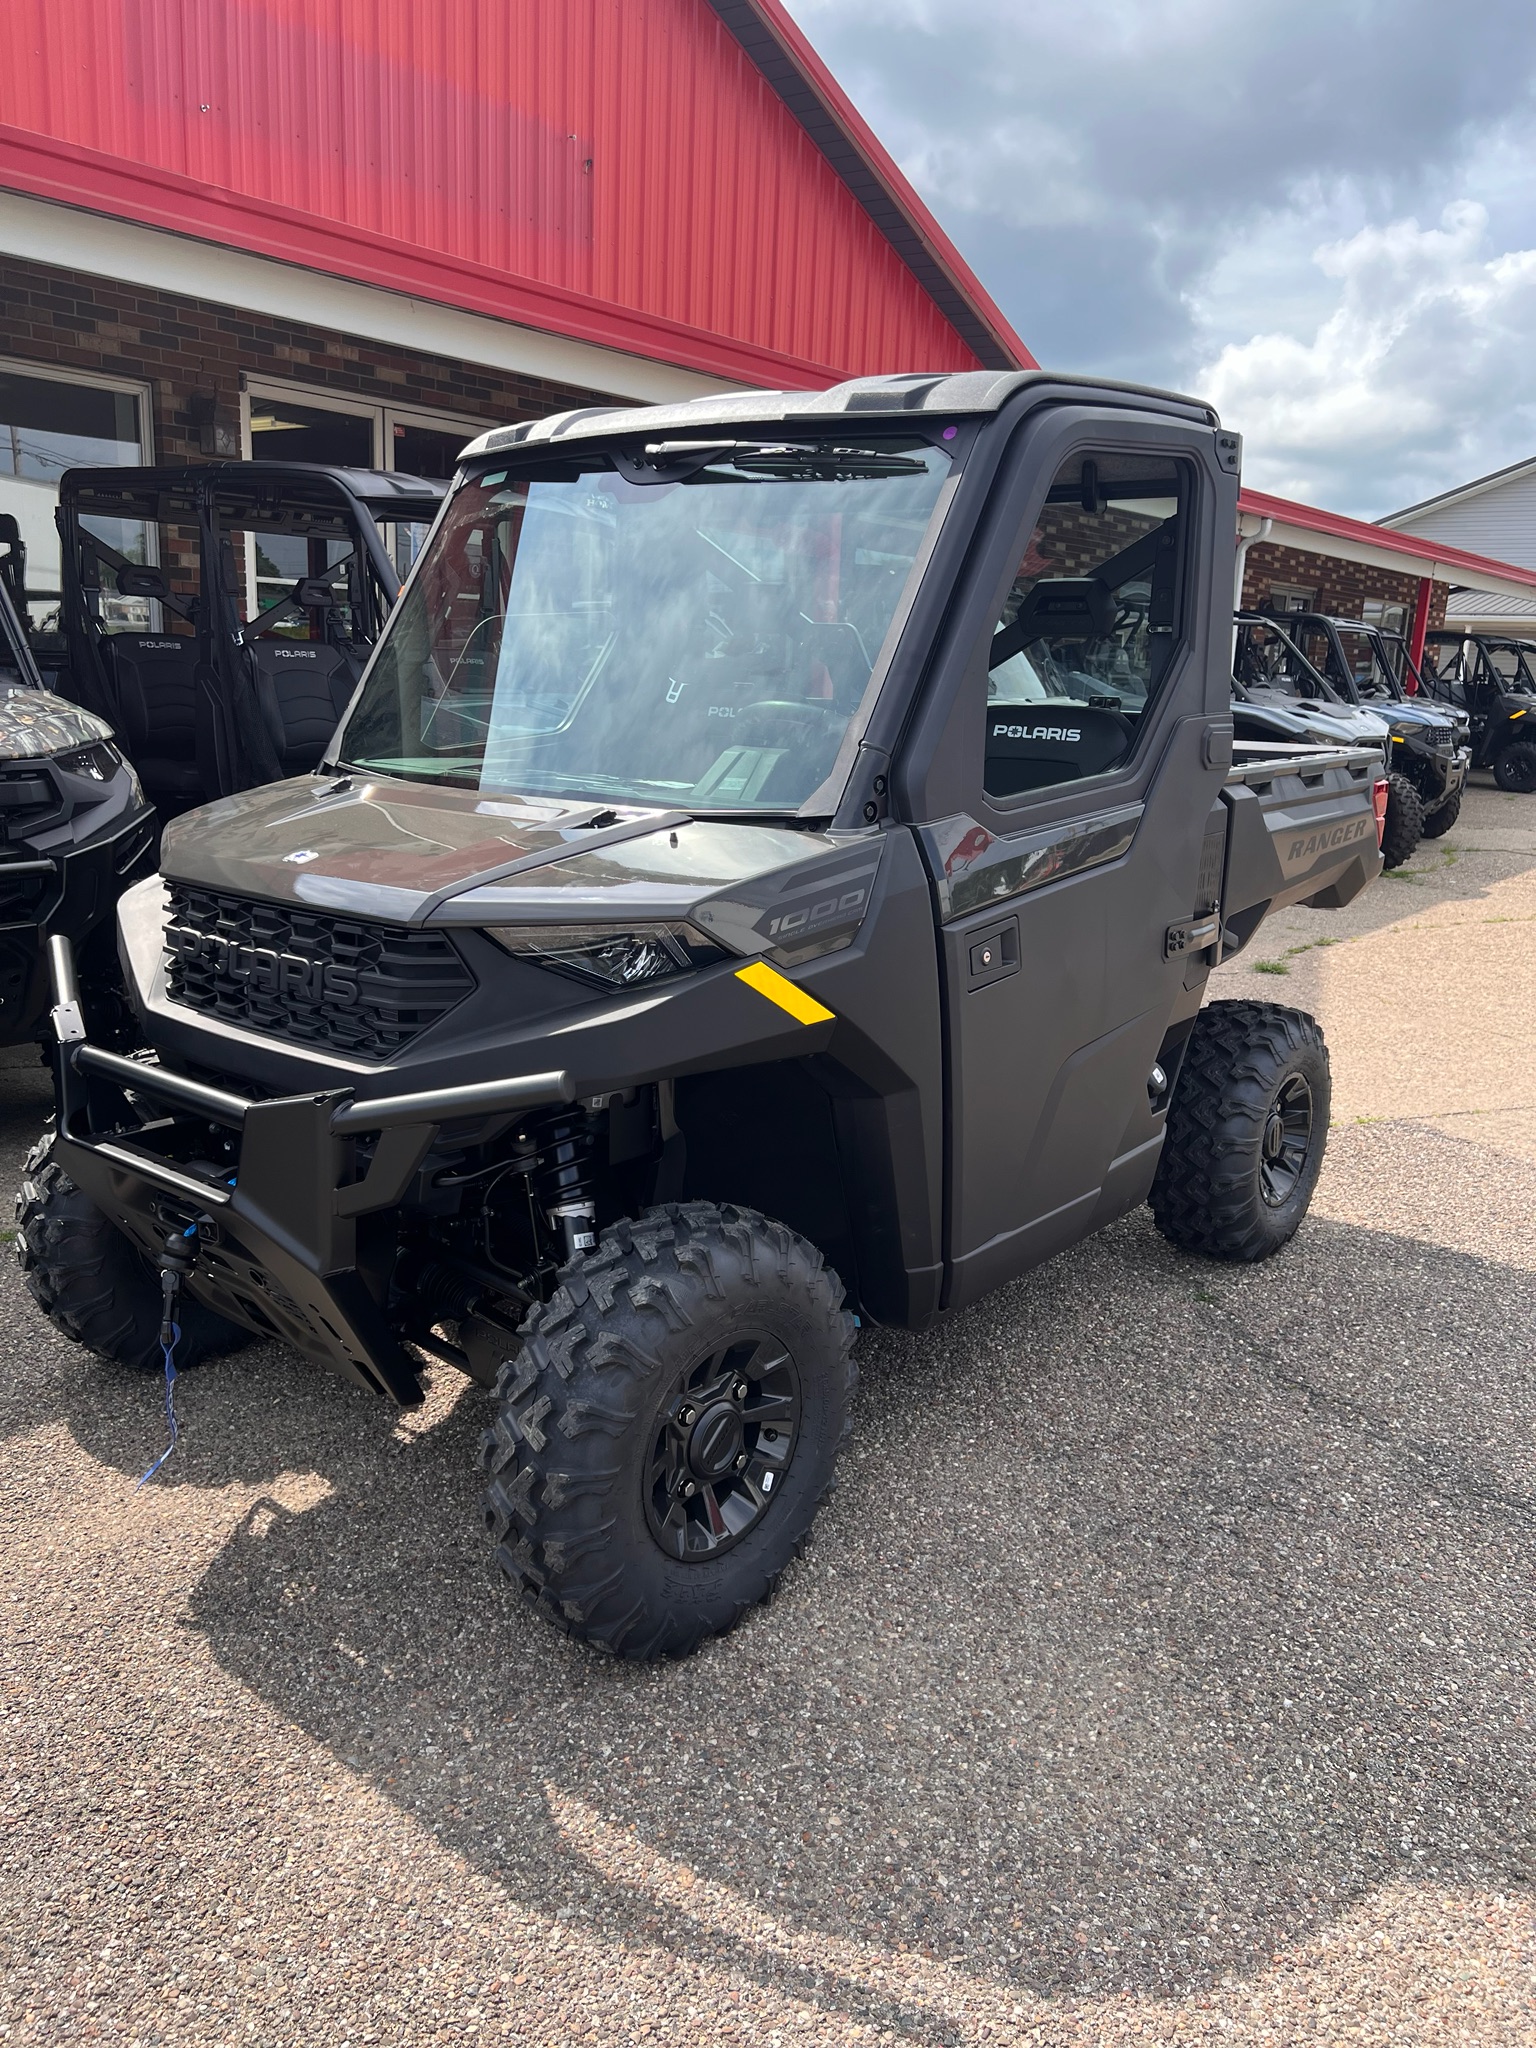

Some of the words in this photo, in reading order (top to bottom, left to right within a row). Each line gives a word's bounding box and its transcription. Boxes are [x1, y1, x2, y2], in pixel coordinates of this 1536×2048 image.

[138, 641, 182, 650] POLARIS
[274, 650, 317, 658] POLARIS
[449, 657, 485, 665] POLARIS
[707, 706, 744, 718] POL
[993, 724, 1081, 742] POLARIS
[1287, 818, 1367, 861] RANGER
[769, 888, 865, 936] 1000
[177, 927, 359, 1006] POLARIS
